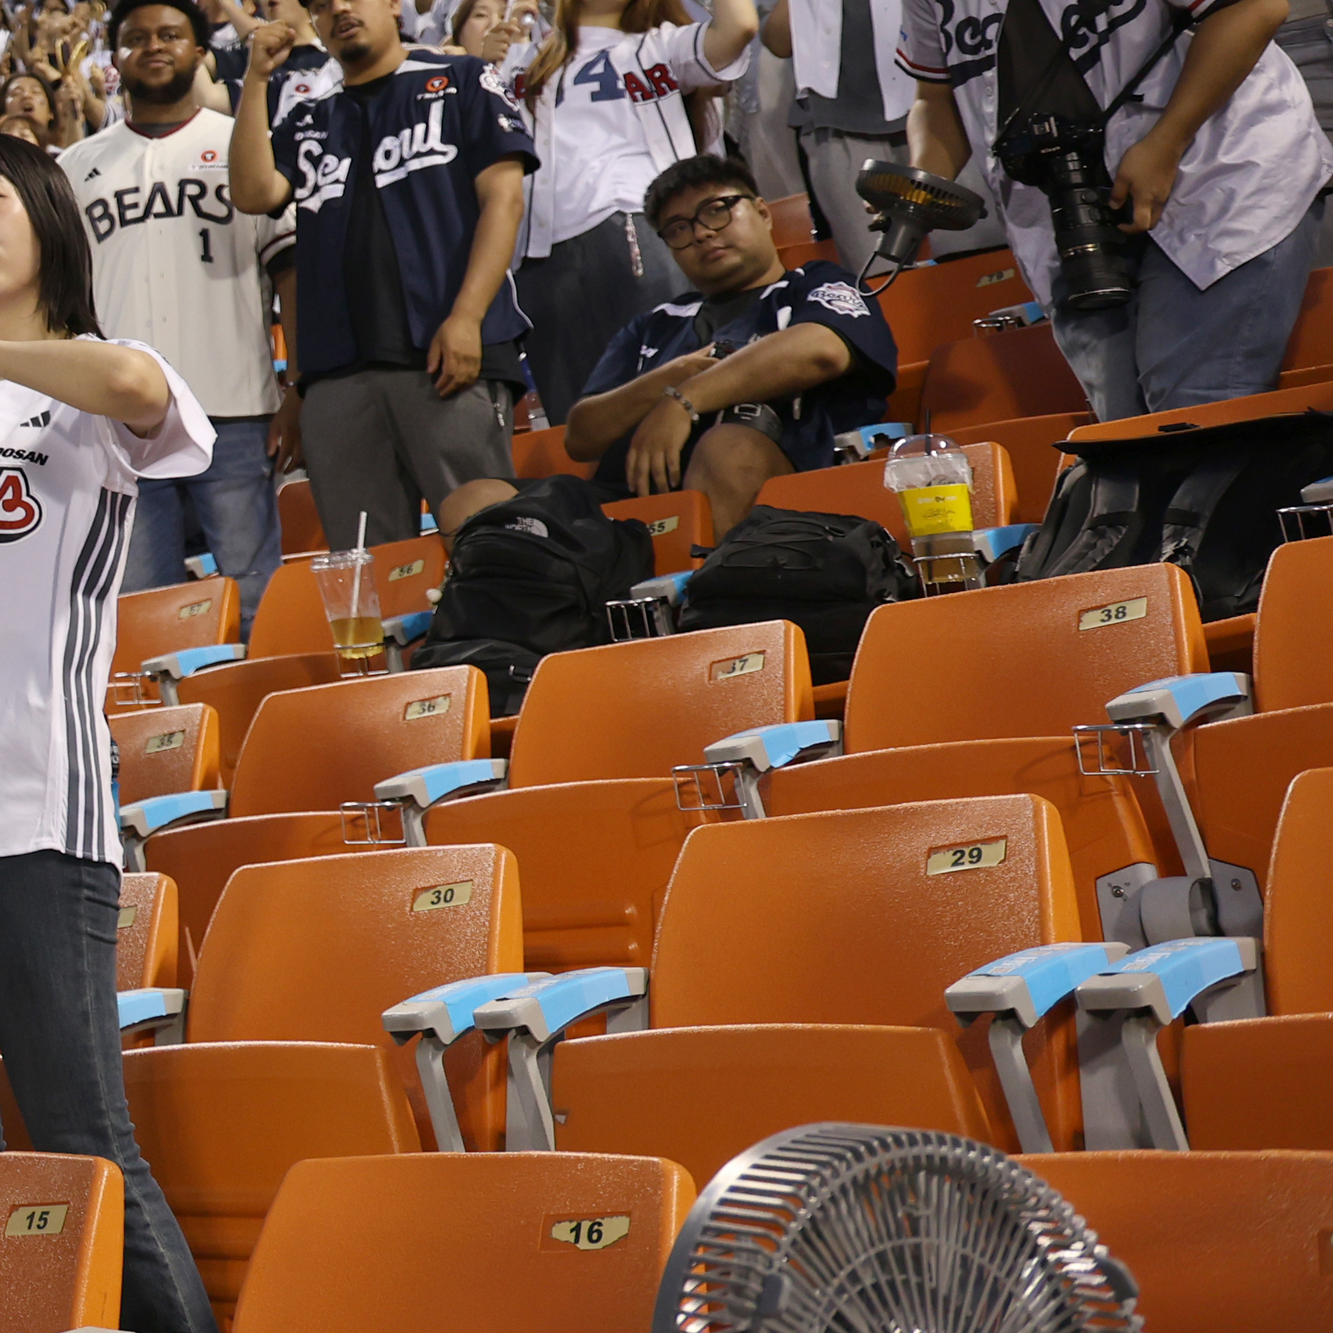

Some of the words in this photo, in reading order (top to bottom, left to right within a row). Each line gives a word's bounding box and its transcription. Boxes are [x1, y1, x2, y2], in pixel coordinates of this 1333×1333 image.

[85, 178, 234, 245] BEARS
[199, 228, 213, 263] 1
[398, 564, 415, 577] 56
[1100, 605, 1128, 624] 38
[417, 700, 436, 715] 36
[156, 735, 174, 748] 35
[951, 846, 983, 868] 29
[430, 886, 456, 906] 30
[25, 1210, 50, 1231] 15
[568, 1220, 604, 1245] 16
